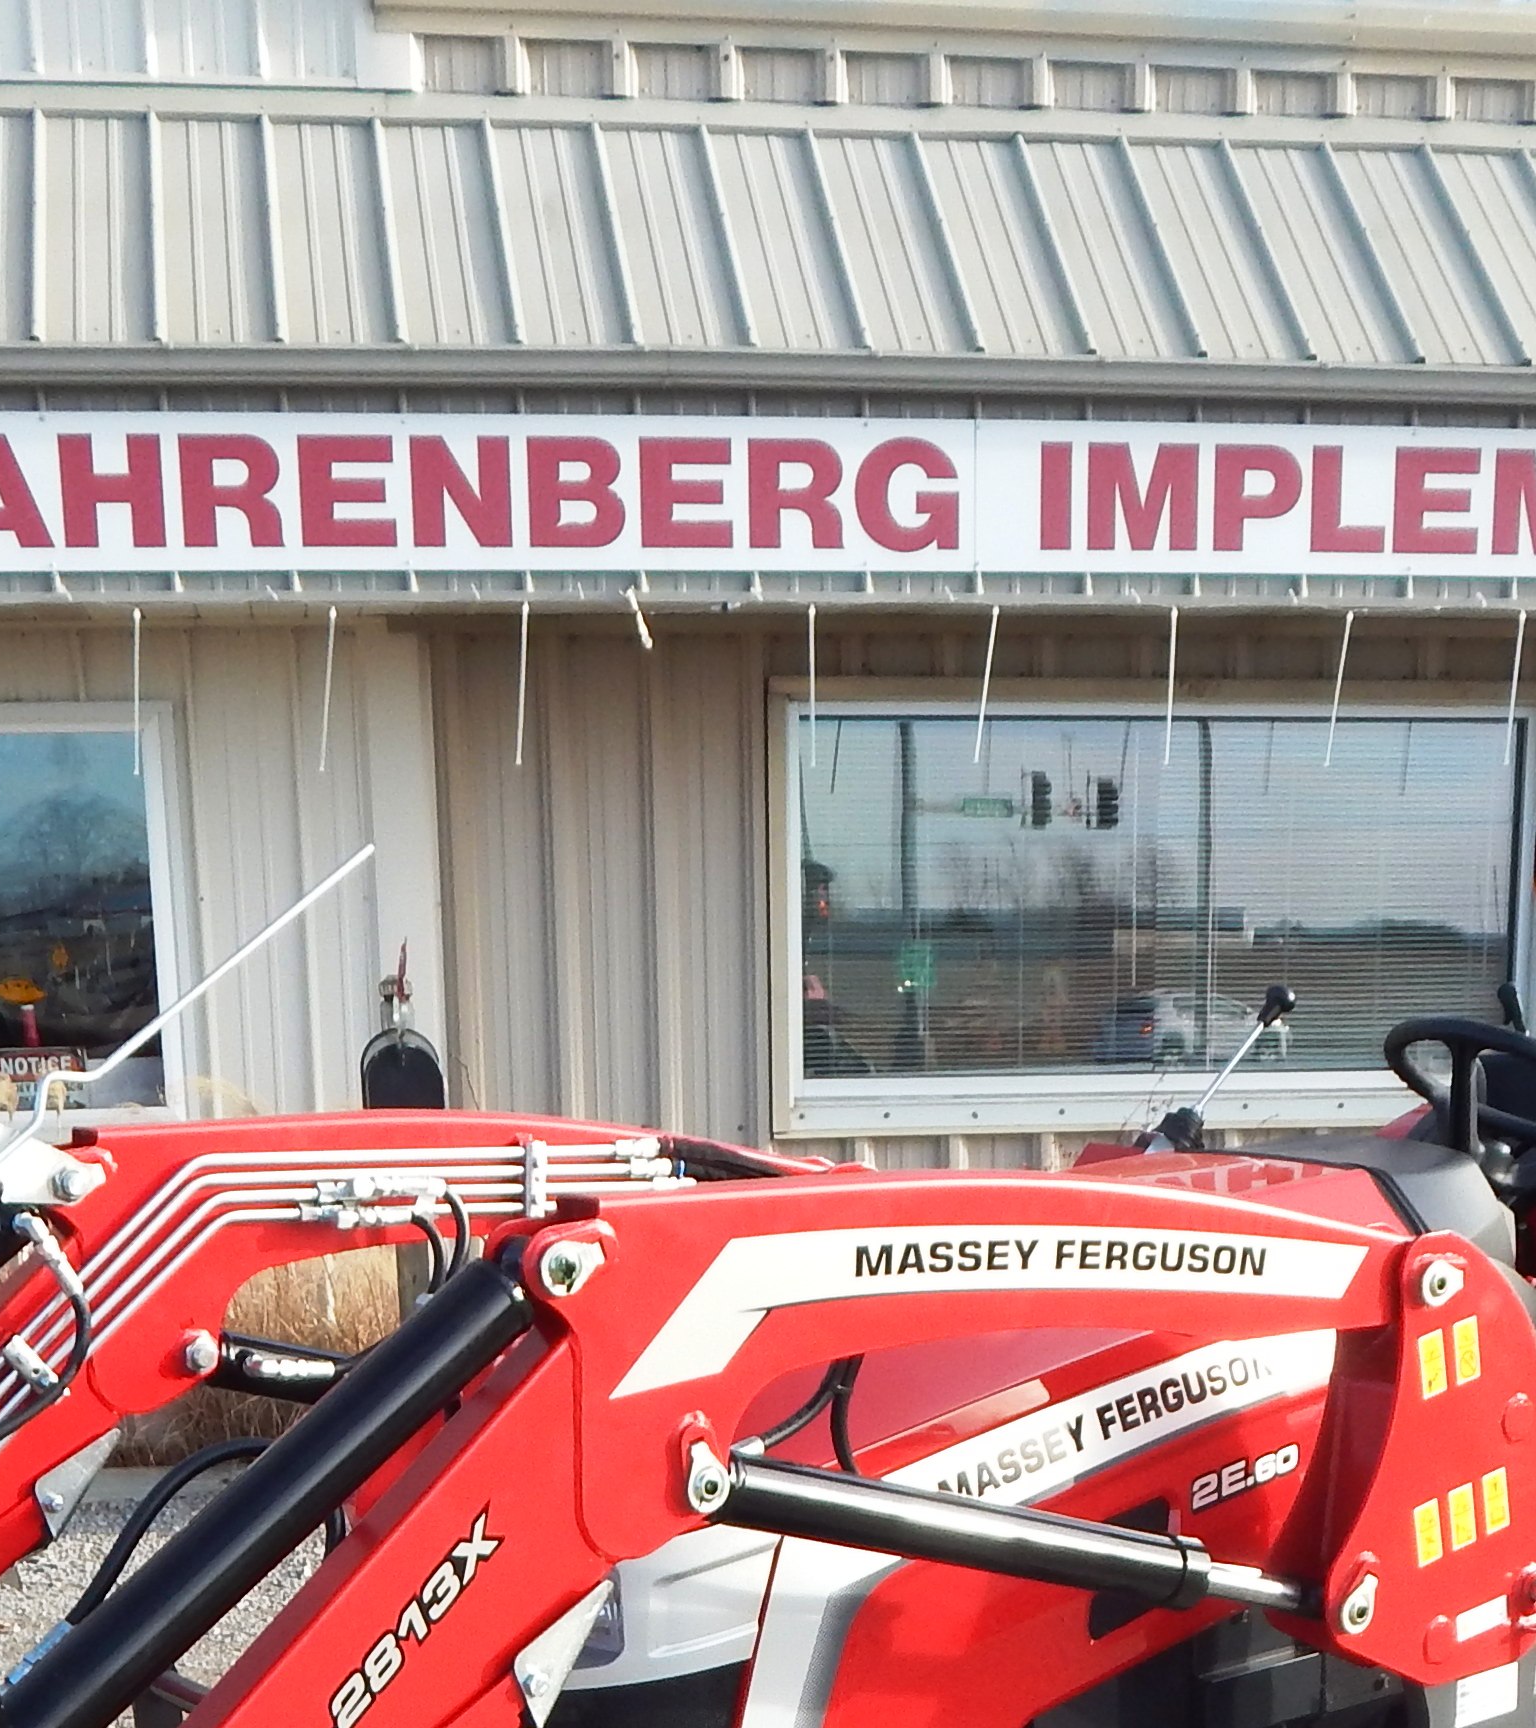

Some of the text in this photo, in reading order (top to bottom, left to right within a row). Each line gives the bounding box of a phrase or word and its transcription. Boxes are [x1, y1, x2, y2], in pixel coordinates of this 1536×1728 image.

[0, 1055, 72, 1077] NOTICE
[855, 1239, 1267, 1278] MASSEY FERGUSON
[1191, 1442, 1300, 1512] 2E.60
